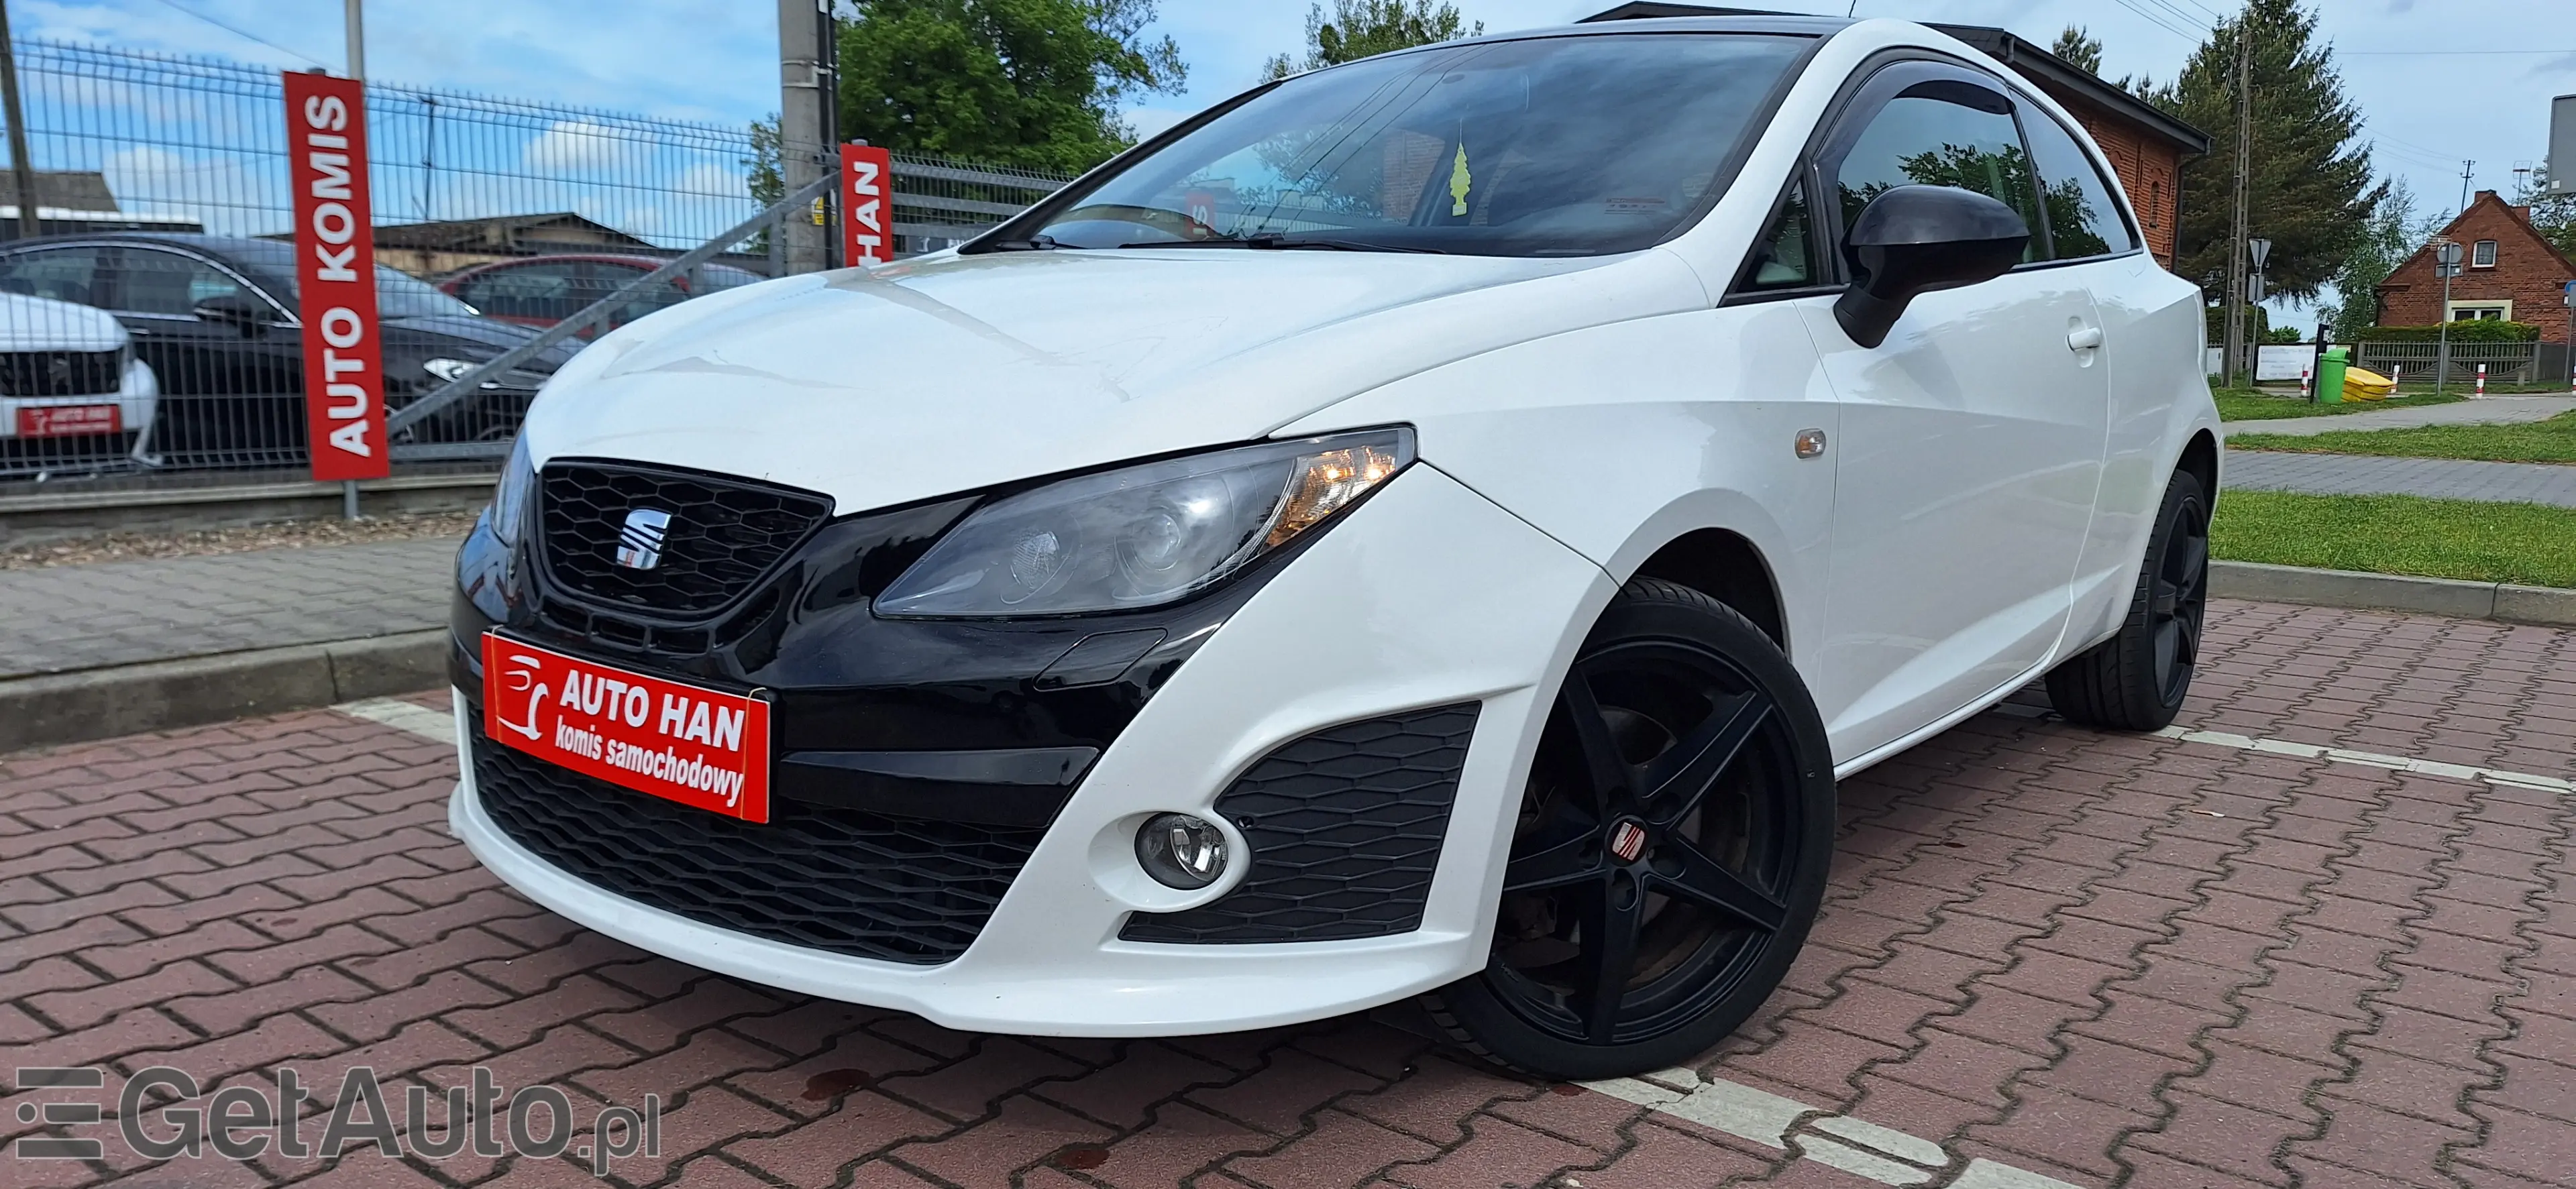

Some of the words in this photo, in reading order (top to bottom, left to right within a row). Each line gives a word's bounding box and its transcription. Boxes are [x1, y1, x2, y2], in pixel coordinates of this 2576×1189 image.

[305, 95, 356, 282] KOMIS
[854, 161, 882, 269] HAN
[321, 307, 370, 457] AUTO
[555, 715, 603, 760] komis
[605, 738, 744, 807] samochodowy
[559, 669, 649, 728] AUTO
[659, 693, 745, 752] HAN
